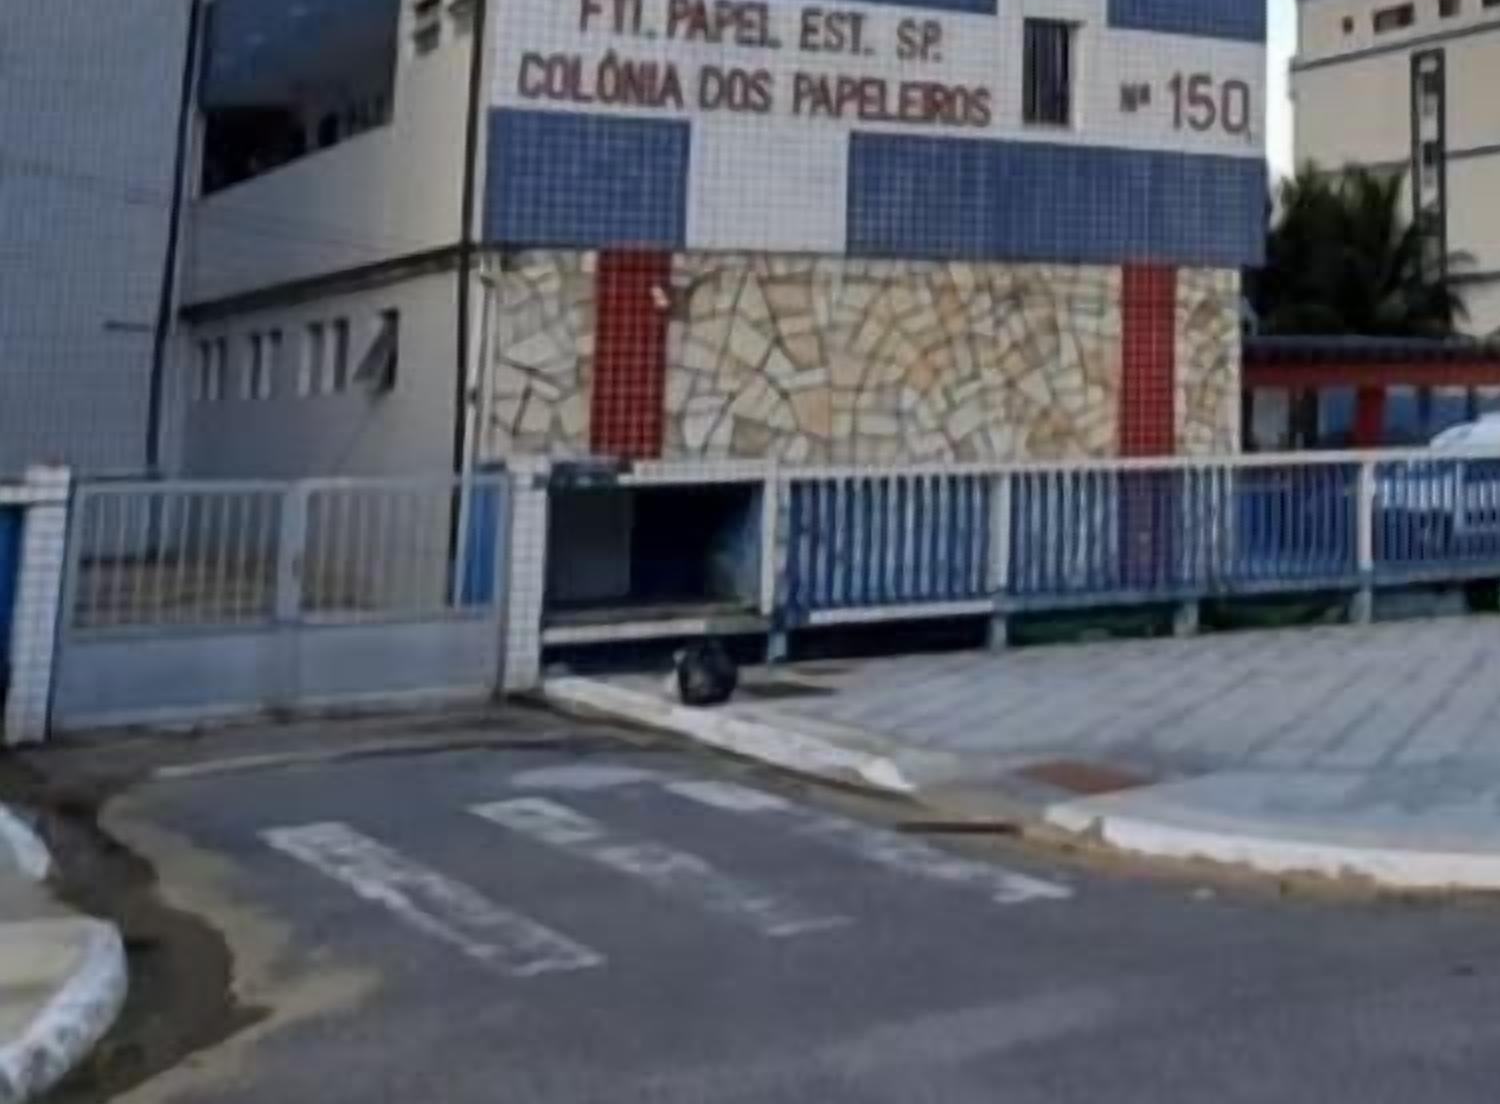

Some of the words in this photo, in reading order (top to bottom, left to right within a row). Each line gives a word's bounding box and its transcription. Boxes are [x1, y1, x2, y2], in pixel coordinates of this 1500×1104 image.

[799, 7, 874, 56] EST.
[897, 18, 942, 63] SP.
[517, 48, 683, 112] COLÔNIA
[699, 64, 774, 114] DOS
[793, 70, 991, 127] PAPELEIROS
[1168, 70, 1249, 135] 150
